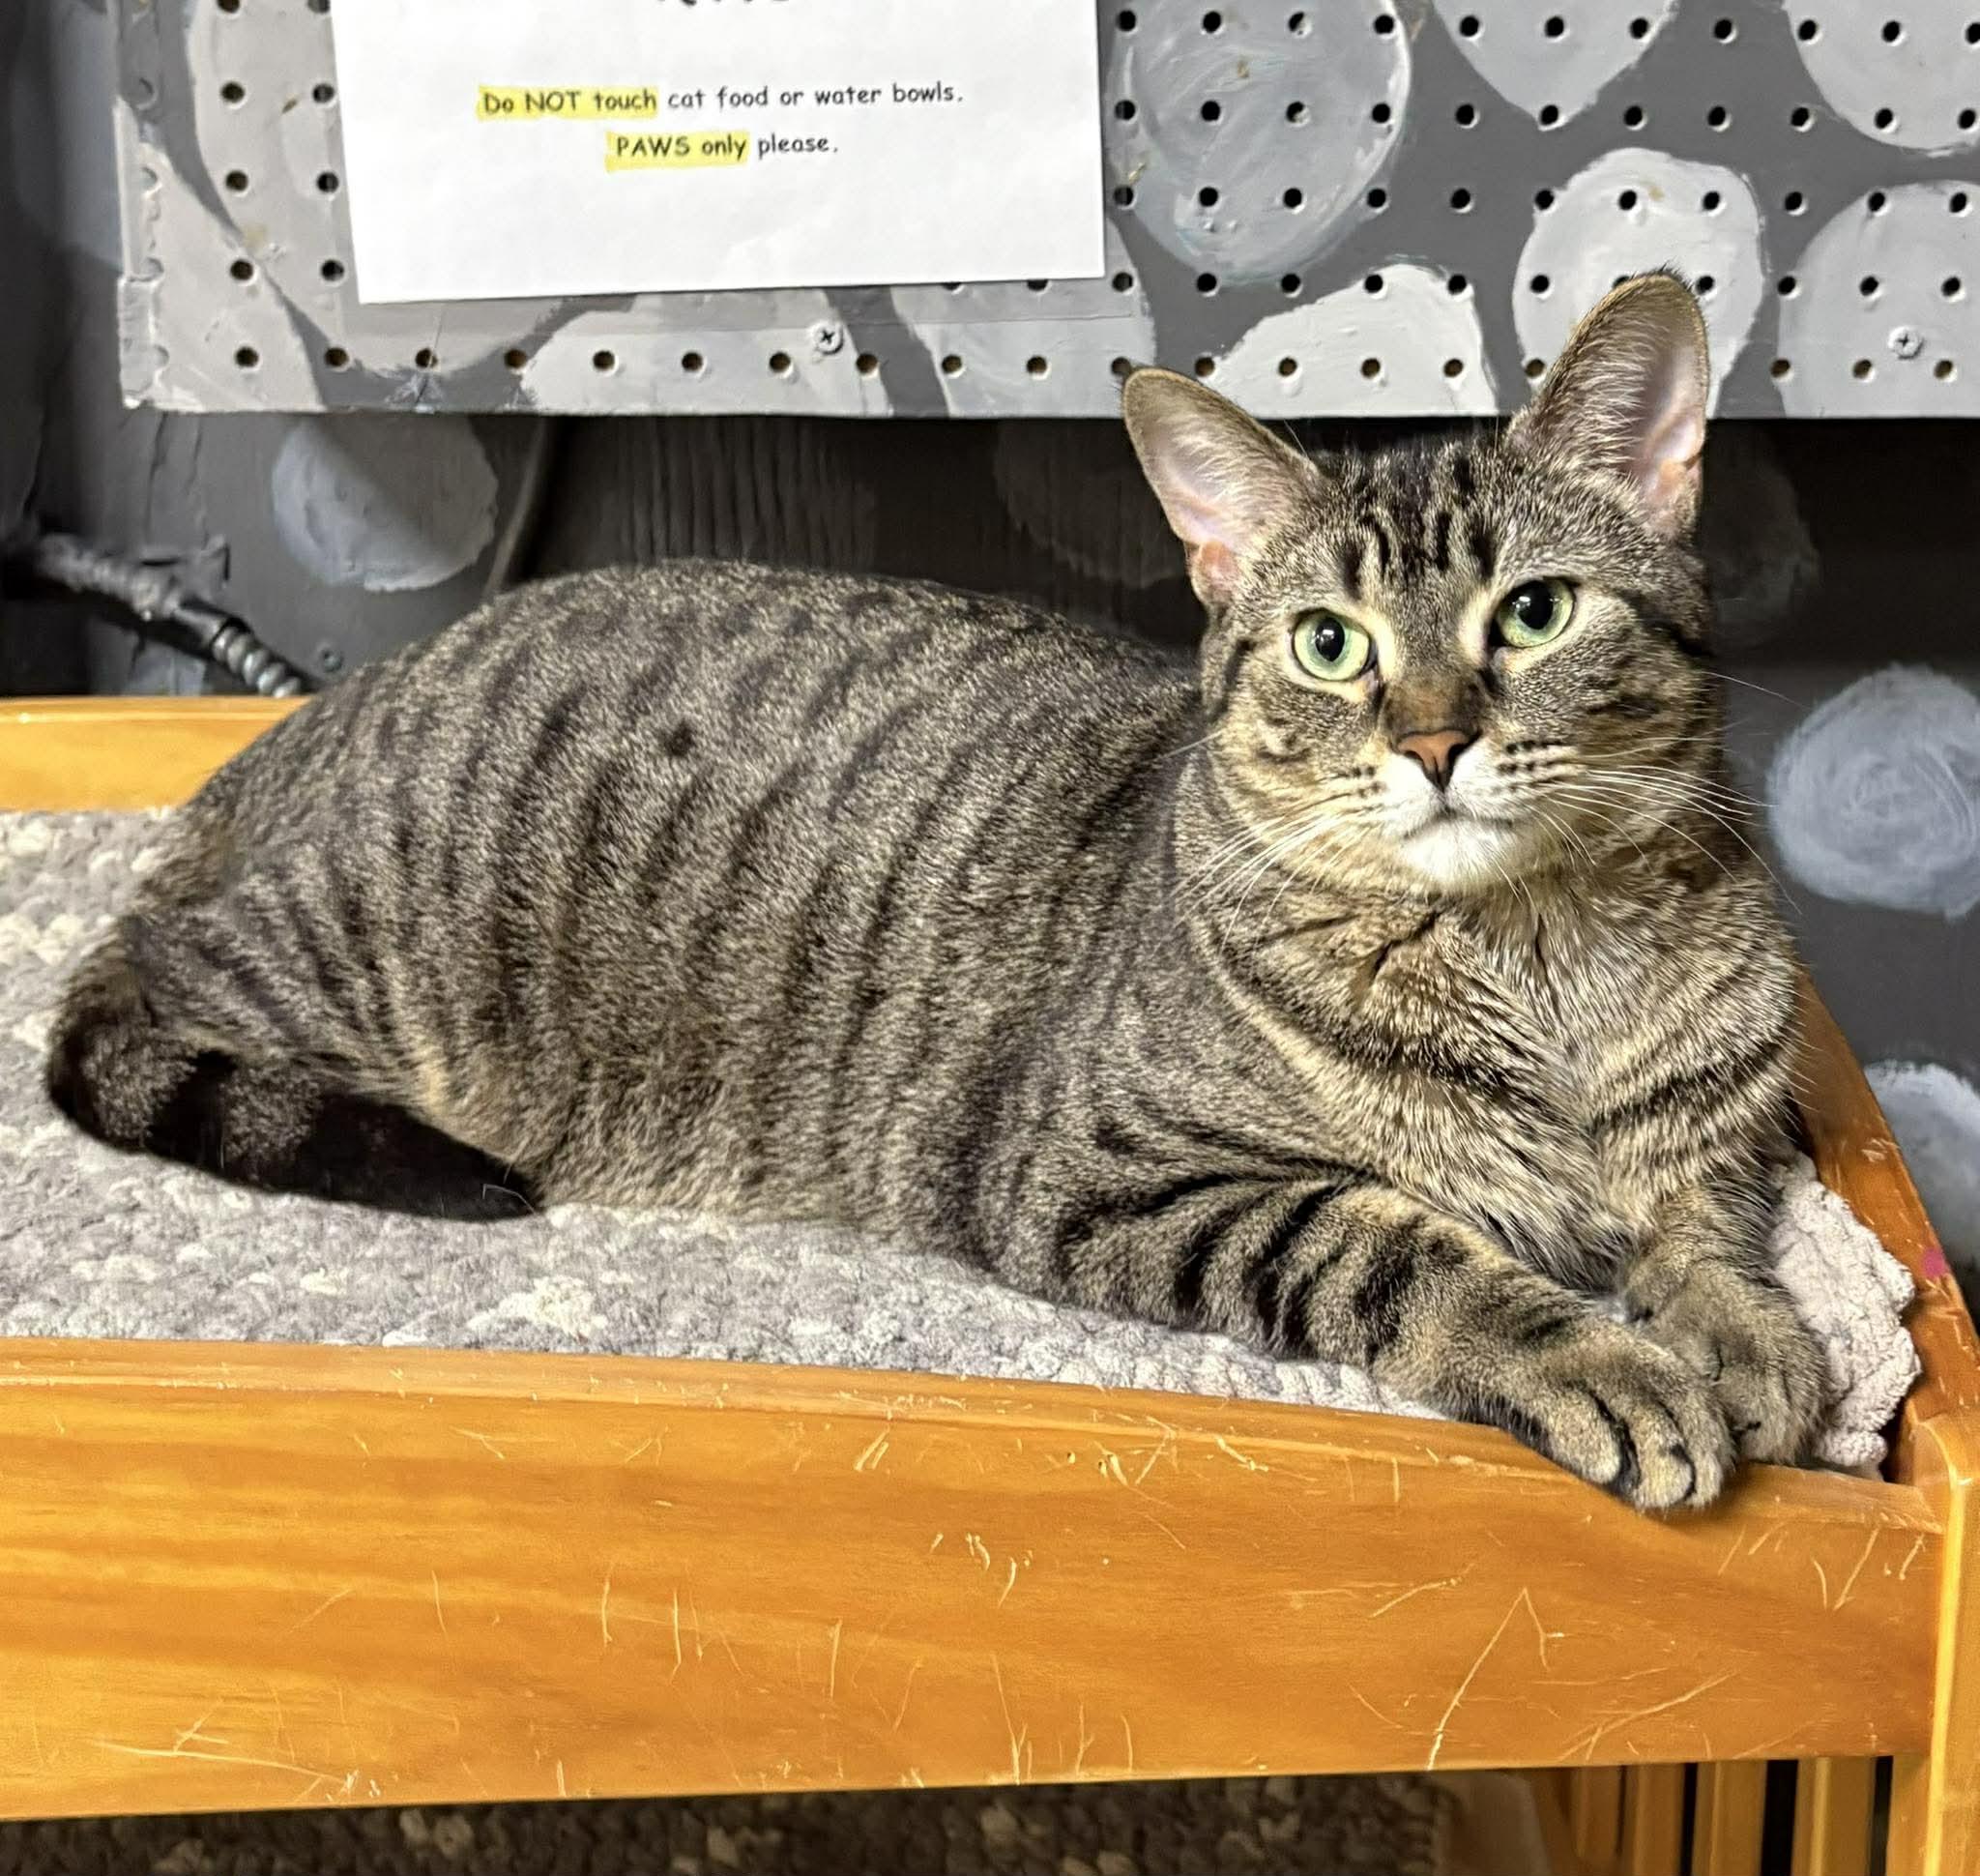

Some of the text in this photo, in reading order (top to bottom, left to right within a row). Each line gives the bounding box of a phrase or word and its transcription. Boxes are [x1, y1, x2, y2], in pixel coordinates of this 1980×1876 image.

[482, 81, 964, 113] Do NOT touch cat food or water bowls.
[616, 133, 839, 161] PAWS only please.
